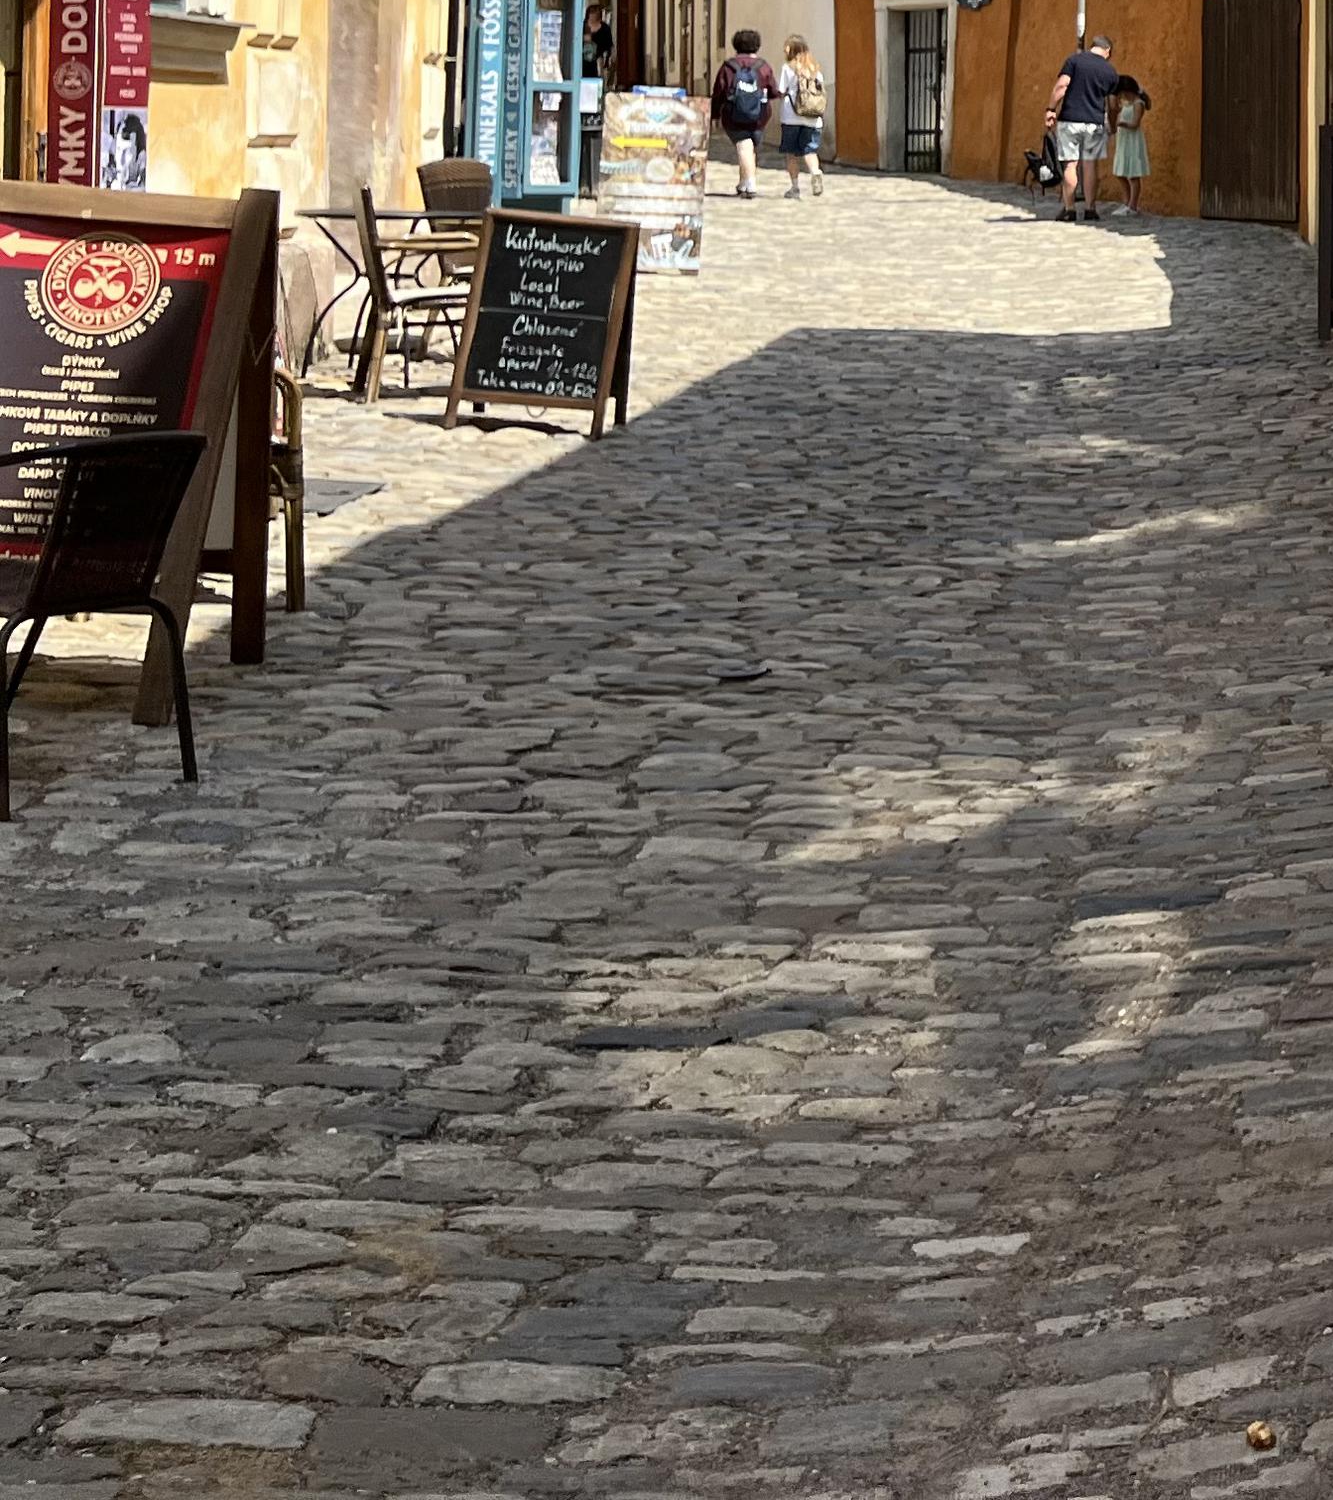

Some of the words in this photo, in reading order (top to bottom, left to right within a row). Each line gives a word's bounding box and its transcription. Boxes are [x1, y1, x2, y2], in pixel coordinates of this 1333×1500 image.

[175, 248, 194, 265] 15
[199, 252, 216, 266] m
[24, 279, 46, 320] PIPES
[44, 323, 94, 350] CIGARS
[105, 323, 147, 348] WINE
[145, 285, 174, 325] SHOP
[60, 380, 95, 393] PIPES
